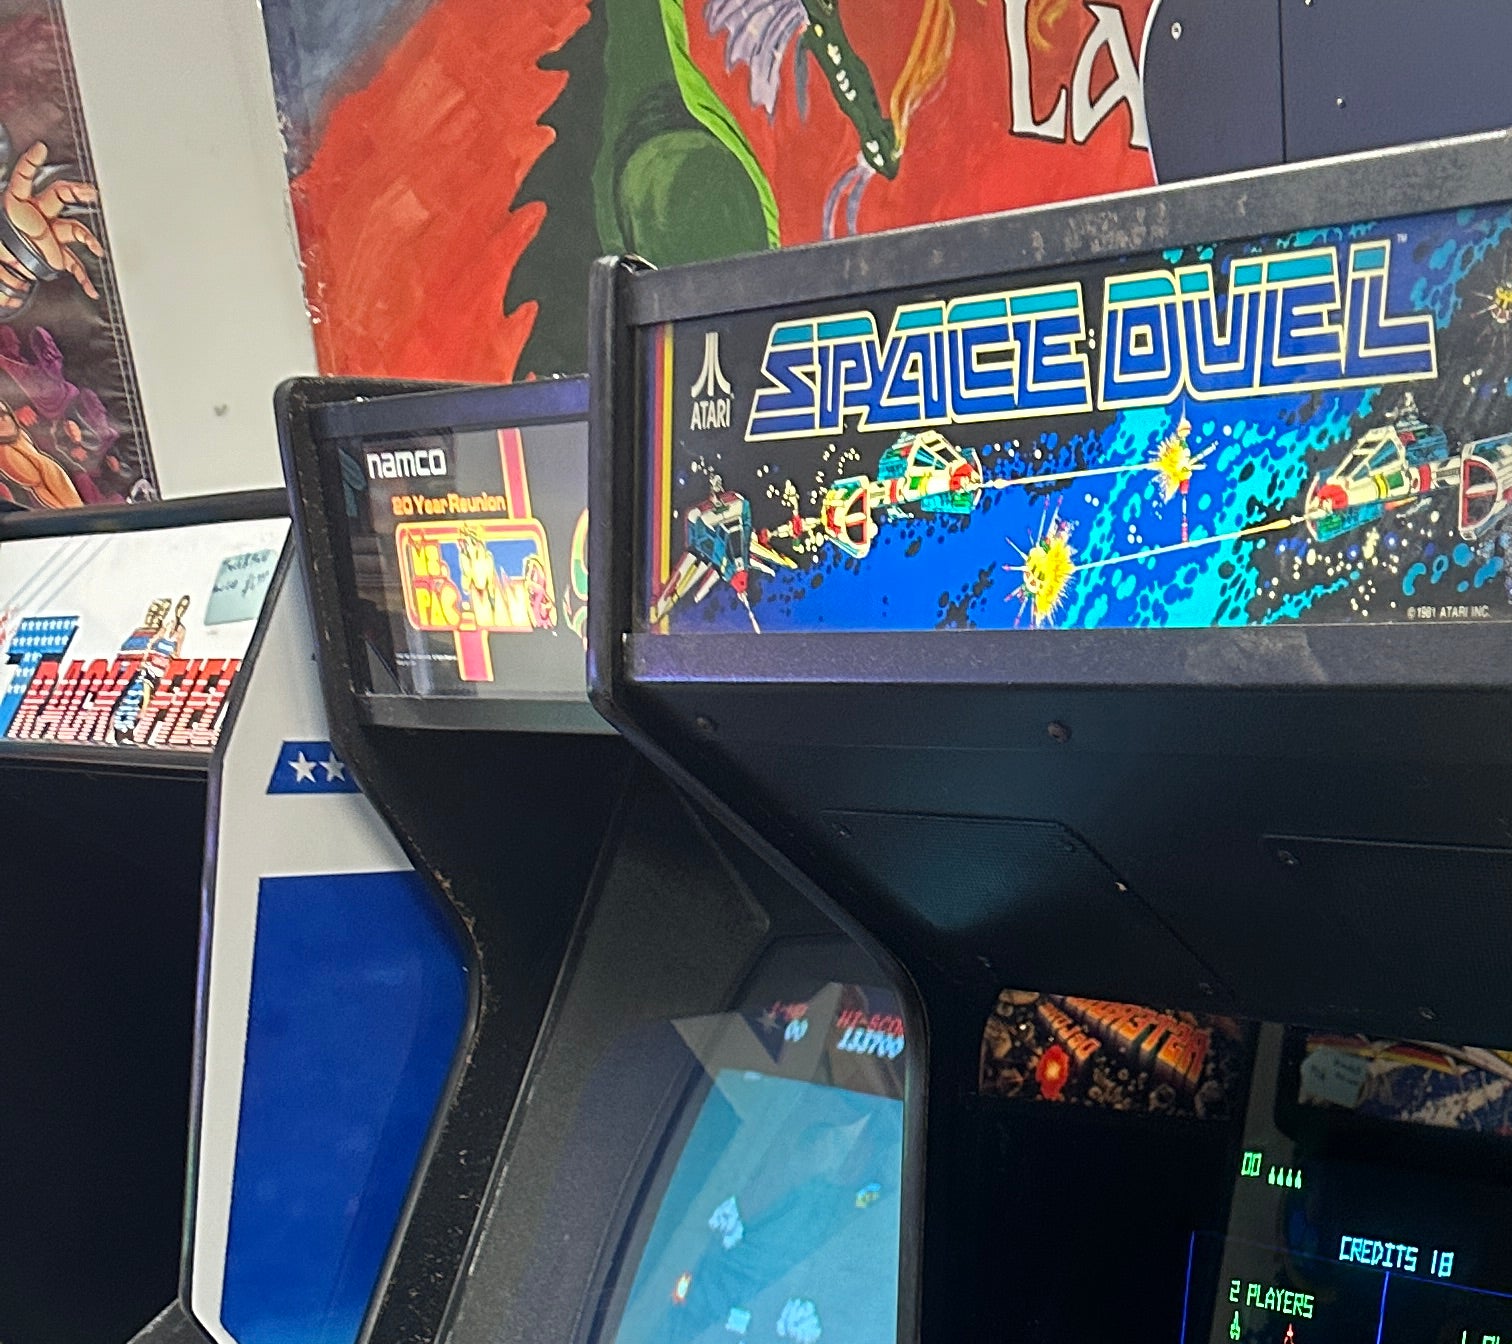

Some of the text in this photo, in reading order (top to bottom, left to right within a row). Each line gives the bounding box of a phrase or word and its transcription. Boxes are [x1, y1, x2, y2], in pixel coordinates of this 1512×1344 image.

[744, 239, 1437, 442] SPACE DUEL
[690, 398, 731, 430] ATARI
[367, 448, 447, 479] namco
[412, 495, 449, 514] Year
[448, 491, 507, 513] Reunion
[1439, 606, 1468, 618] ATARI
[1339, 1235, 1454, 1277] CREDITS 18
[1229, 1280, 1314, 1319] 2 PLAYERS
